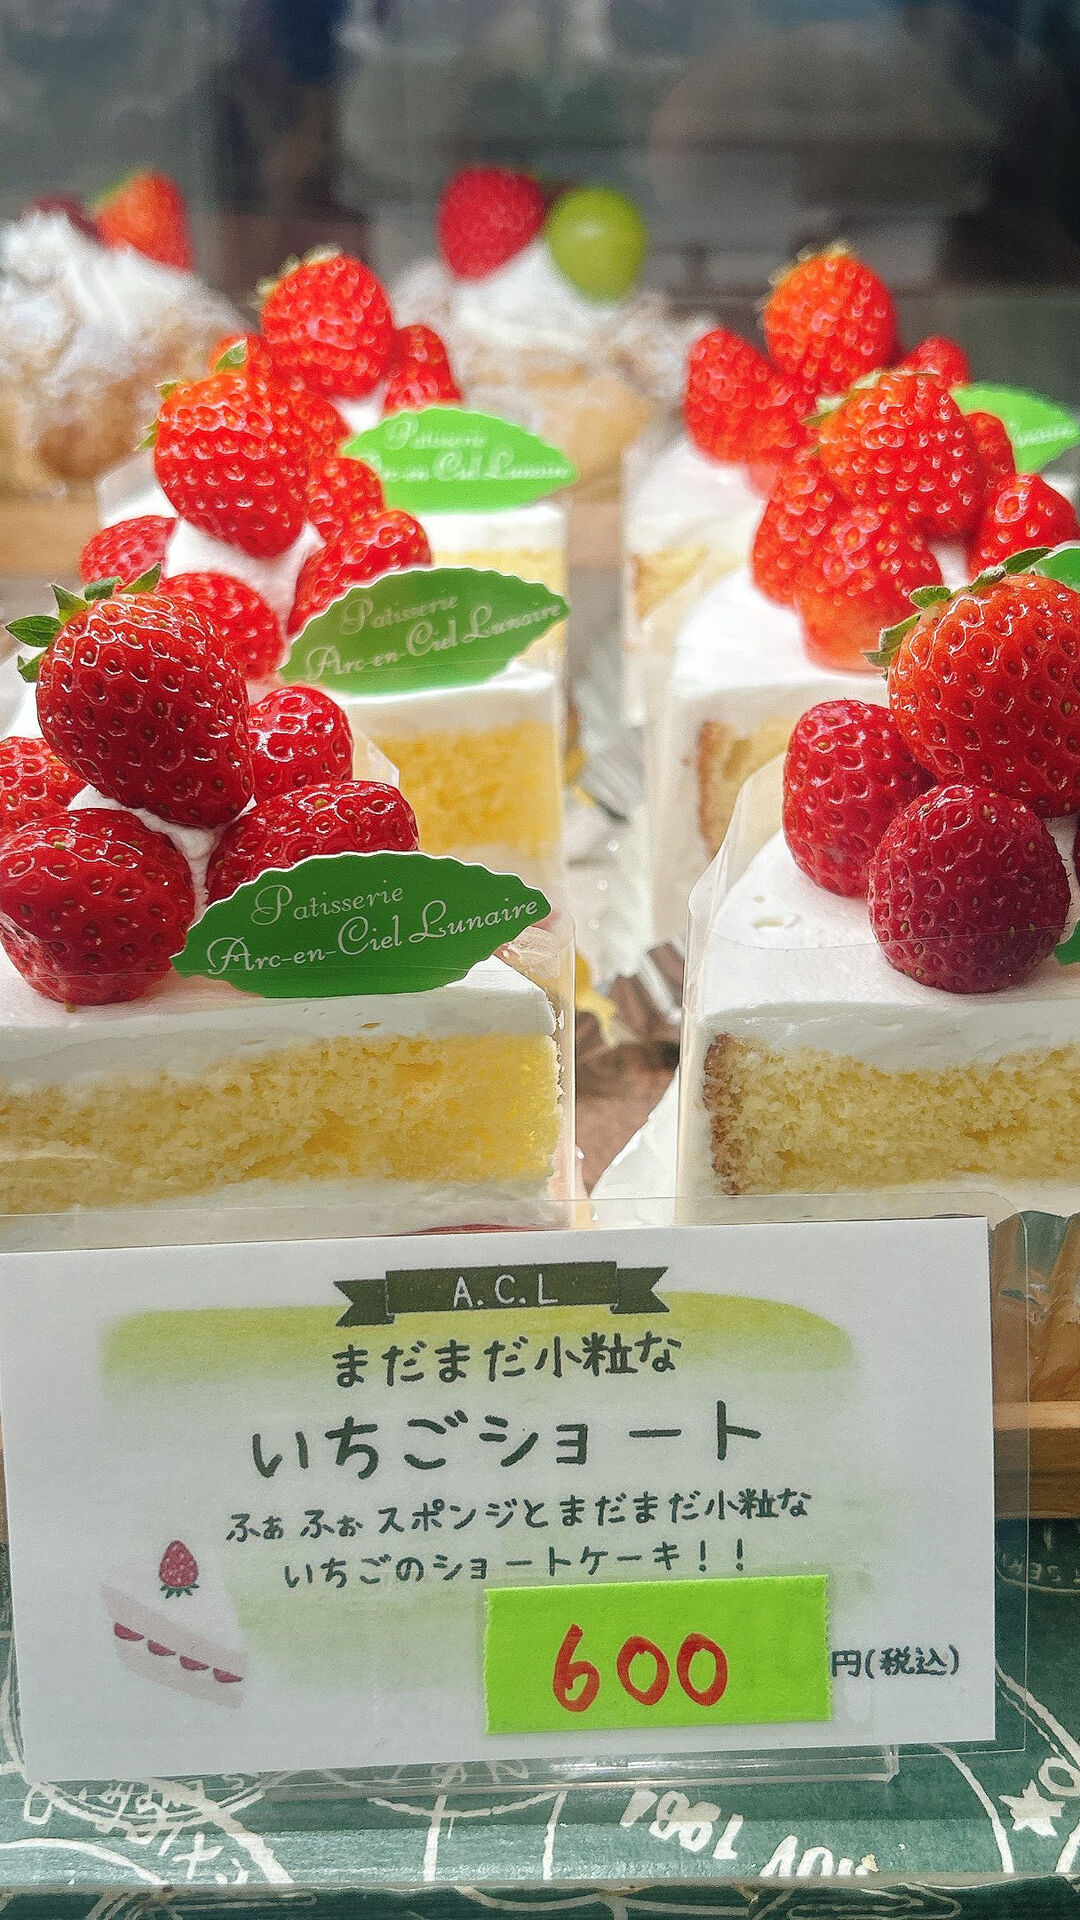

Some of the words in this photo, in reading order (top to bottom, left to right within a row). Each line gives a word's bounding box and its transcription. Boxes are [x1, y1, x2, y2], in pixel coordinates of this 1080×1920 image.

[339, 590, 459, 636] Patisserie
[463, 601, 562, 644] Lunaire
[250, 880, 404, 926] Patisserie
[206, 914, 403, 975] Arc-en-Ciel
[407, 898, 538, 944] Lunaire
[453, 1273, 558, 1309] A.C.L
[332, 1330, 682, 1389] まだまだ小粒な
[251, 1400, 762, 1480] いちごショート
[553, 1624, 728, 1713] 600
[831, 1644, 960, 1680] 円(税込)
